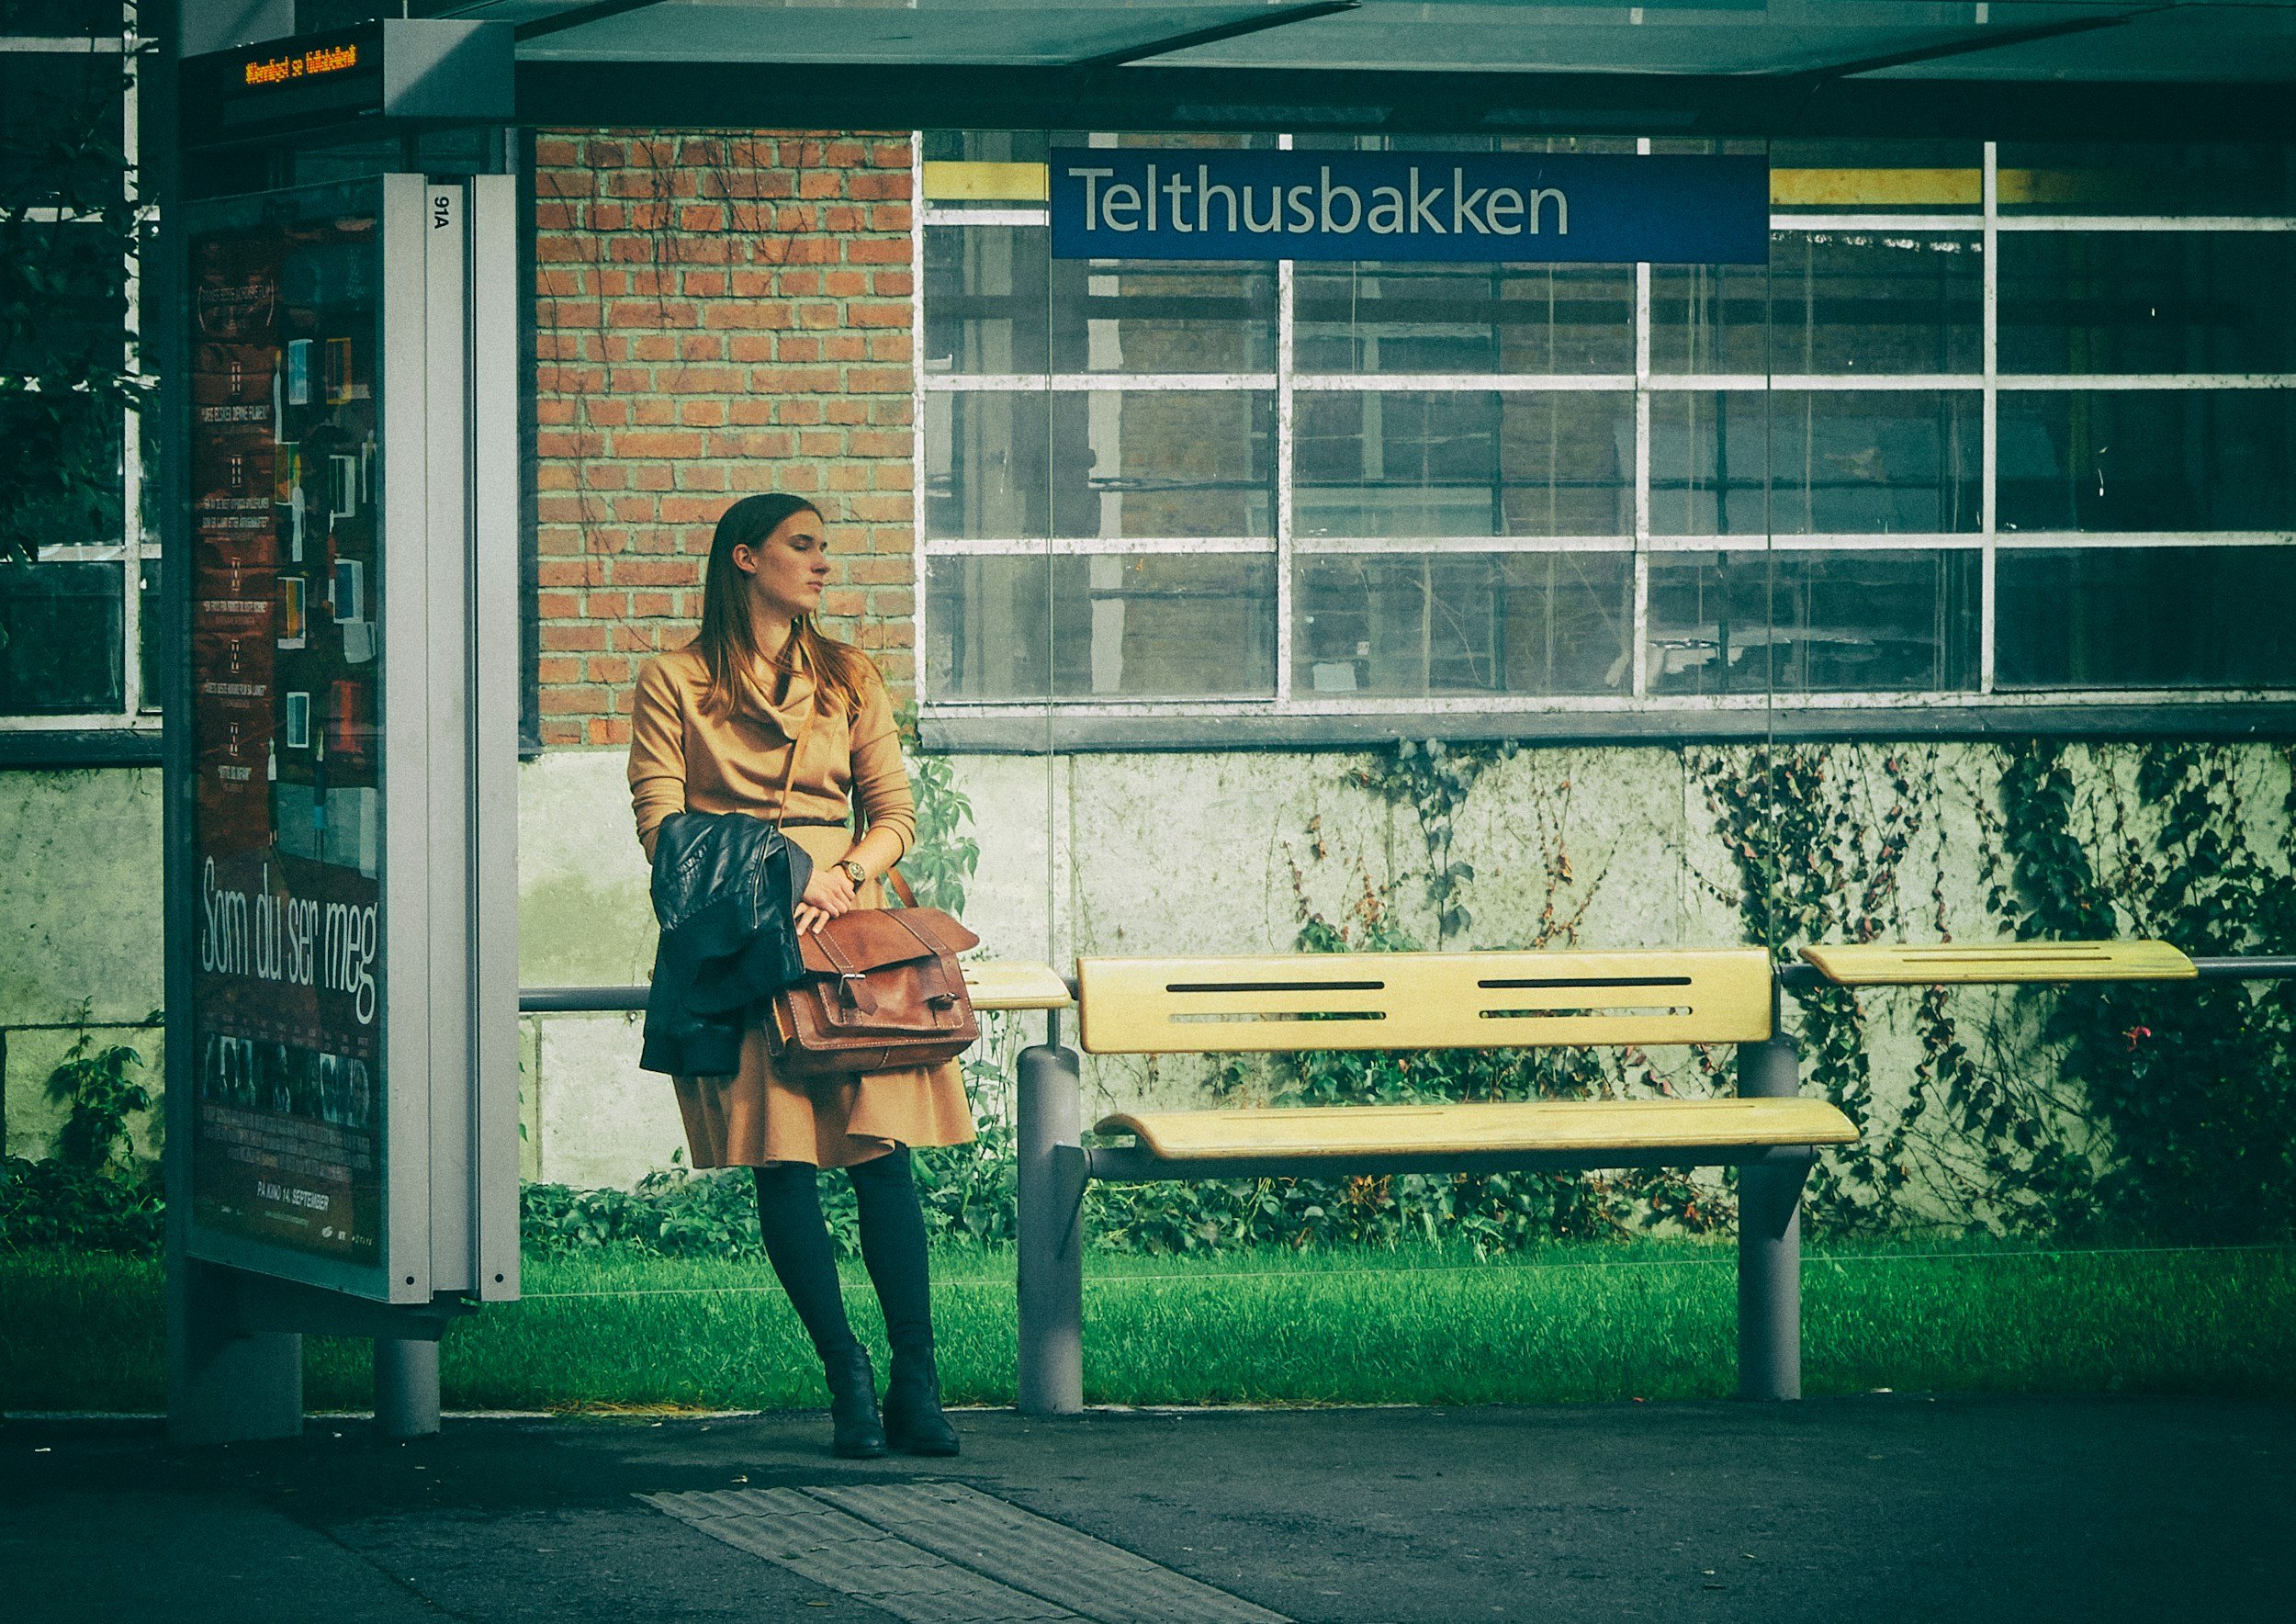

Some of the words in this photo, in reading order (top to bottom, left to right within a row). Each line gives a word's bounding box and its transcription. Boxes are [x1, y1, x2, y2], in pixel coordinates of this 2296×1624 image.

[434, 196, 449, 230] 91A
[1068, 164, 1568, 235] Telthusbakken
[202, 854, 249, 976] Som
[255, 863, 282, 980] du
[287, 897, 319, 986] ser
[324, 901, 378, 1025] meg
[291, 1189, 330, 1212] SEPTEMBER
